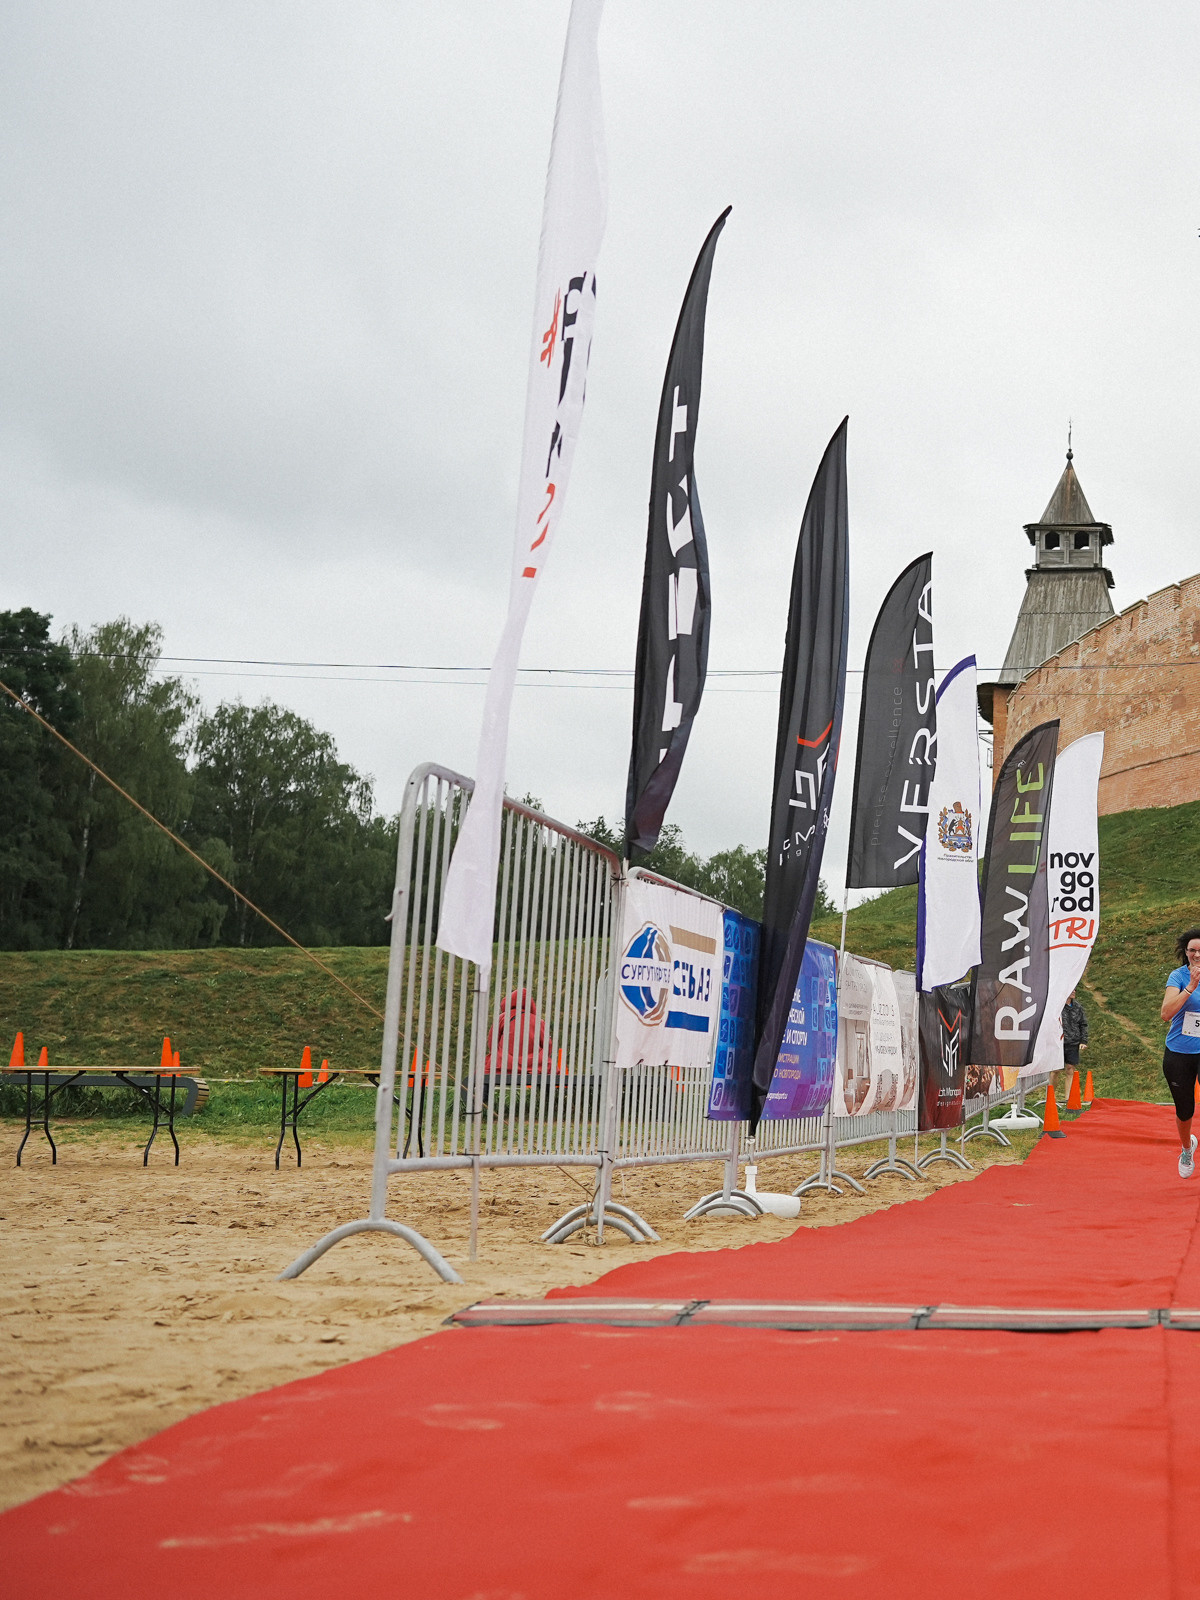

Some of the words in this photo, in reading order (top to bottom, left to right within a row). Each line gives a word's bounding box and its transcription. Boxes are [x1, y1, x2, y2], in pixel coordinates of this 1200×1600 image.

[1007, 762, 1045, 874] LIFE
[1050, 852, 1095, 869] nov
[1060, 871, 1094, 896] go
[1051, 888, 1094, 913] rod
[1049, 917, 1095, 940] TRI
